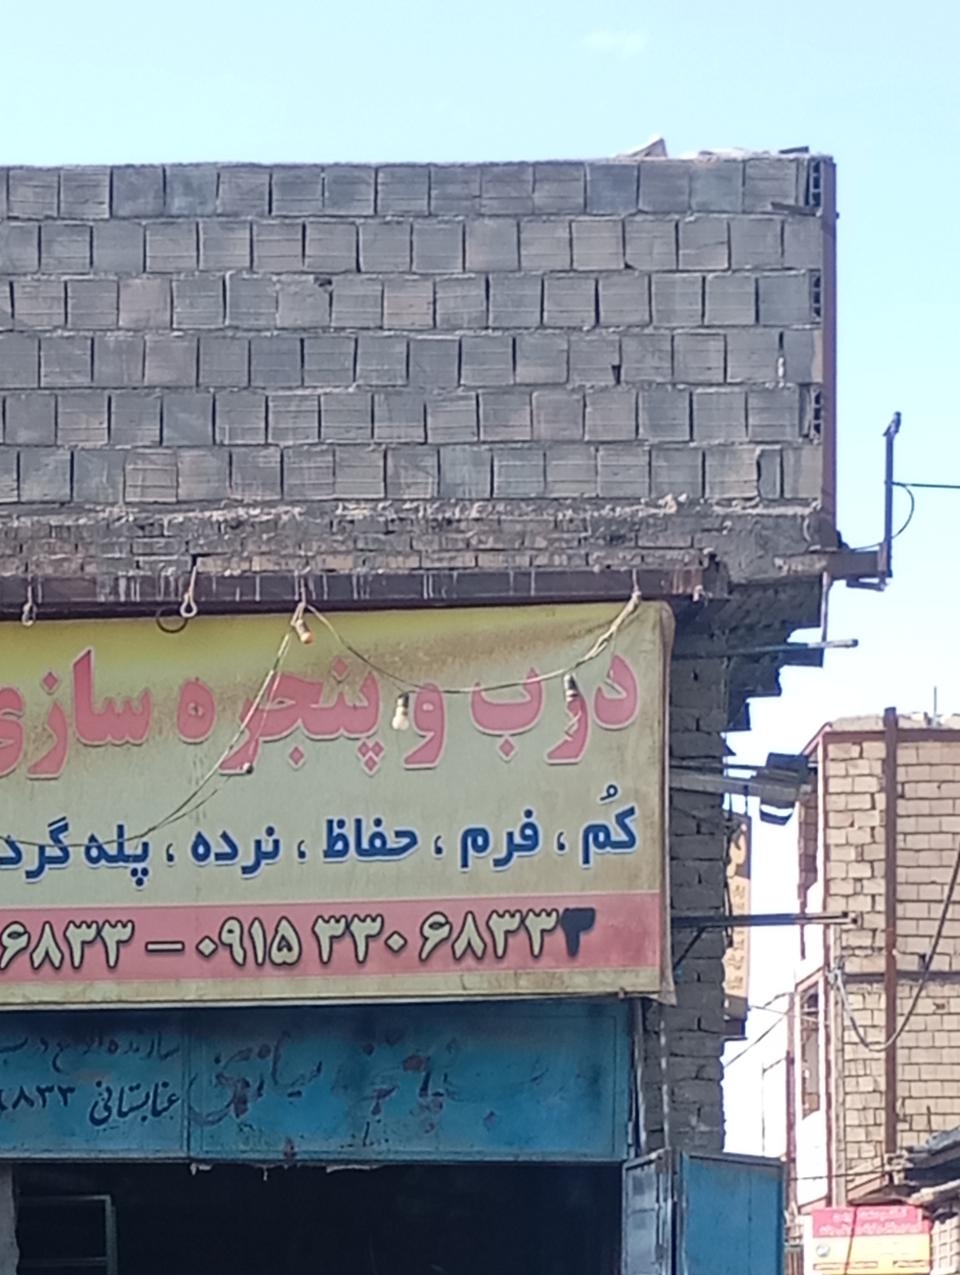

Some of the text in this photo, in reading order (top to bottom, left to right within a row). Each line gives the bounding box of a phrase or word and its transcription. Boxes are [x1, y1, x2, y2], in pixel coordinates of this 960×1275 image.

[175, 656, 381, 776] پنجره
[404, 681, 446, 769] و
[469, 653, 639, 765] درب
[83, 823, 151, 888] پله
[190, 825, 282, 877] نرده
[321, 814, 419, 861] حفاظ
[458, 808, 542, 870] فرم
